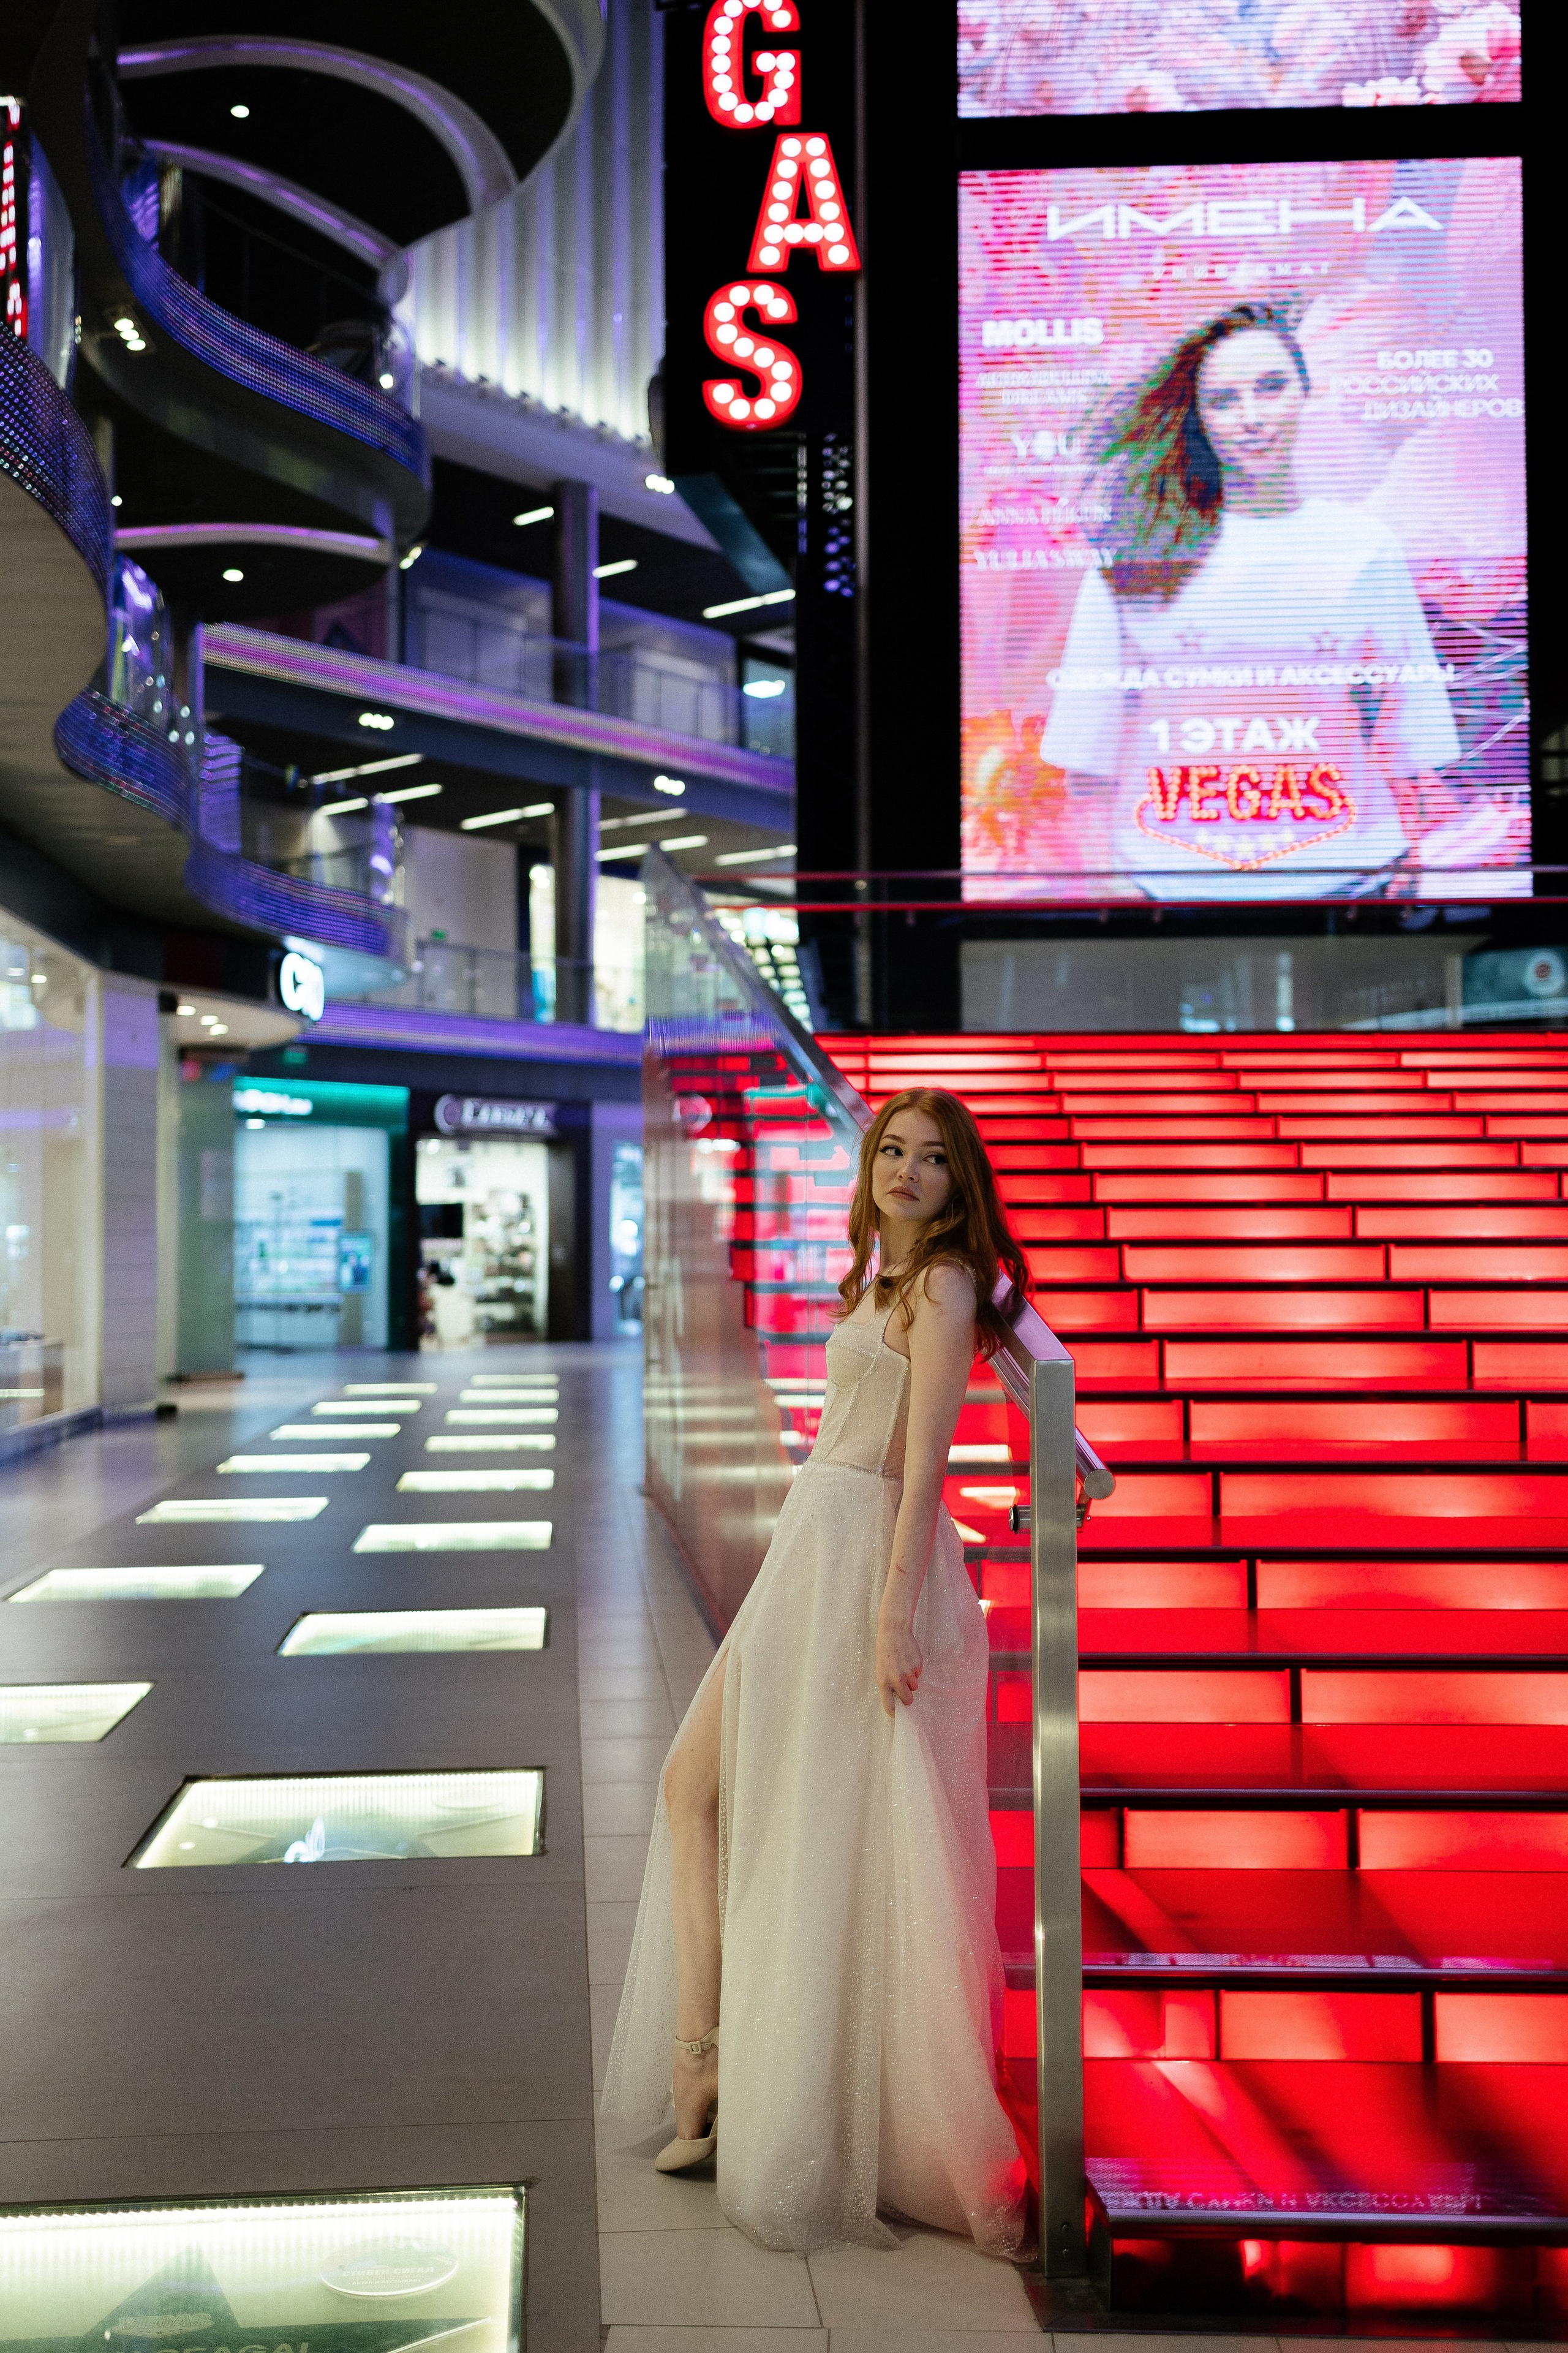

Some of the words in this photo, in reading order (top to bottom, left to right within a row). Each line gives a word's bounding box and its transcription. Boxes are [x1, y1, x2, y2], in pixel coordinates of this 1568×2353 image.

[1046, 196, 1445, 241] ИМЕНА
[981, 317, 1104, 347] MOLLIS
[1377, 350, 1459, 369] БОЛЕЕ
[1463, 348, 1494, 368] 30
[1329, 370, 1499, 395] РОССИЙСКИХ
[1361, 396, 1525, 420] ДИЗАЙНЕРОВ
[1164, 665, 1253, 689] СУМКИ
[1256, 664, 1276, 686] И
[1280, 663, 1456, 686] АКСЕССУАРЫ
[1150, 717, 1170, 753] 1
[1179, 716, 1321, 752] ЭТАЖ
[1145, 763, 1343, 821] VEGAS
[342, 2268, 390, 2277] СТИВЕН
